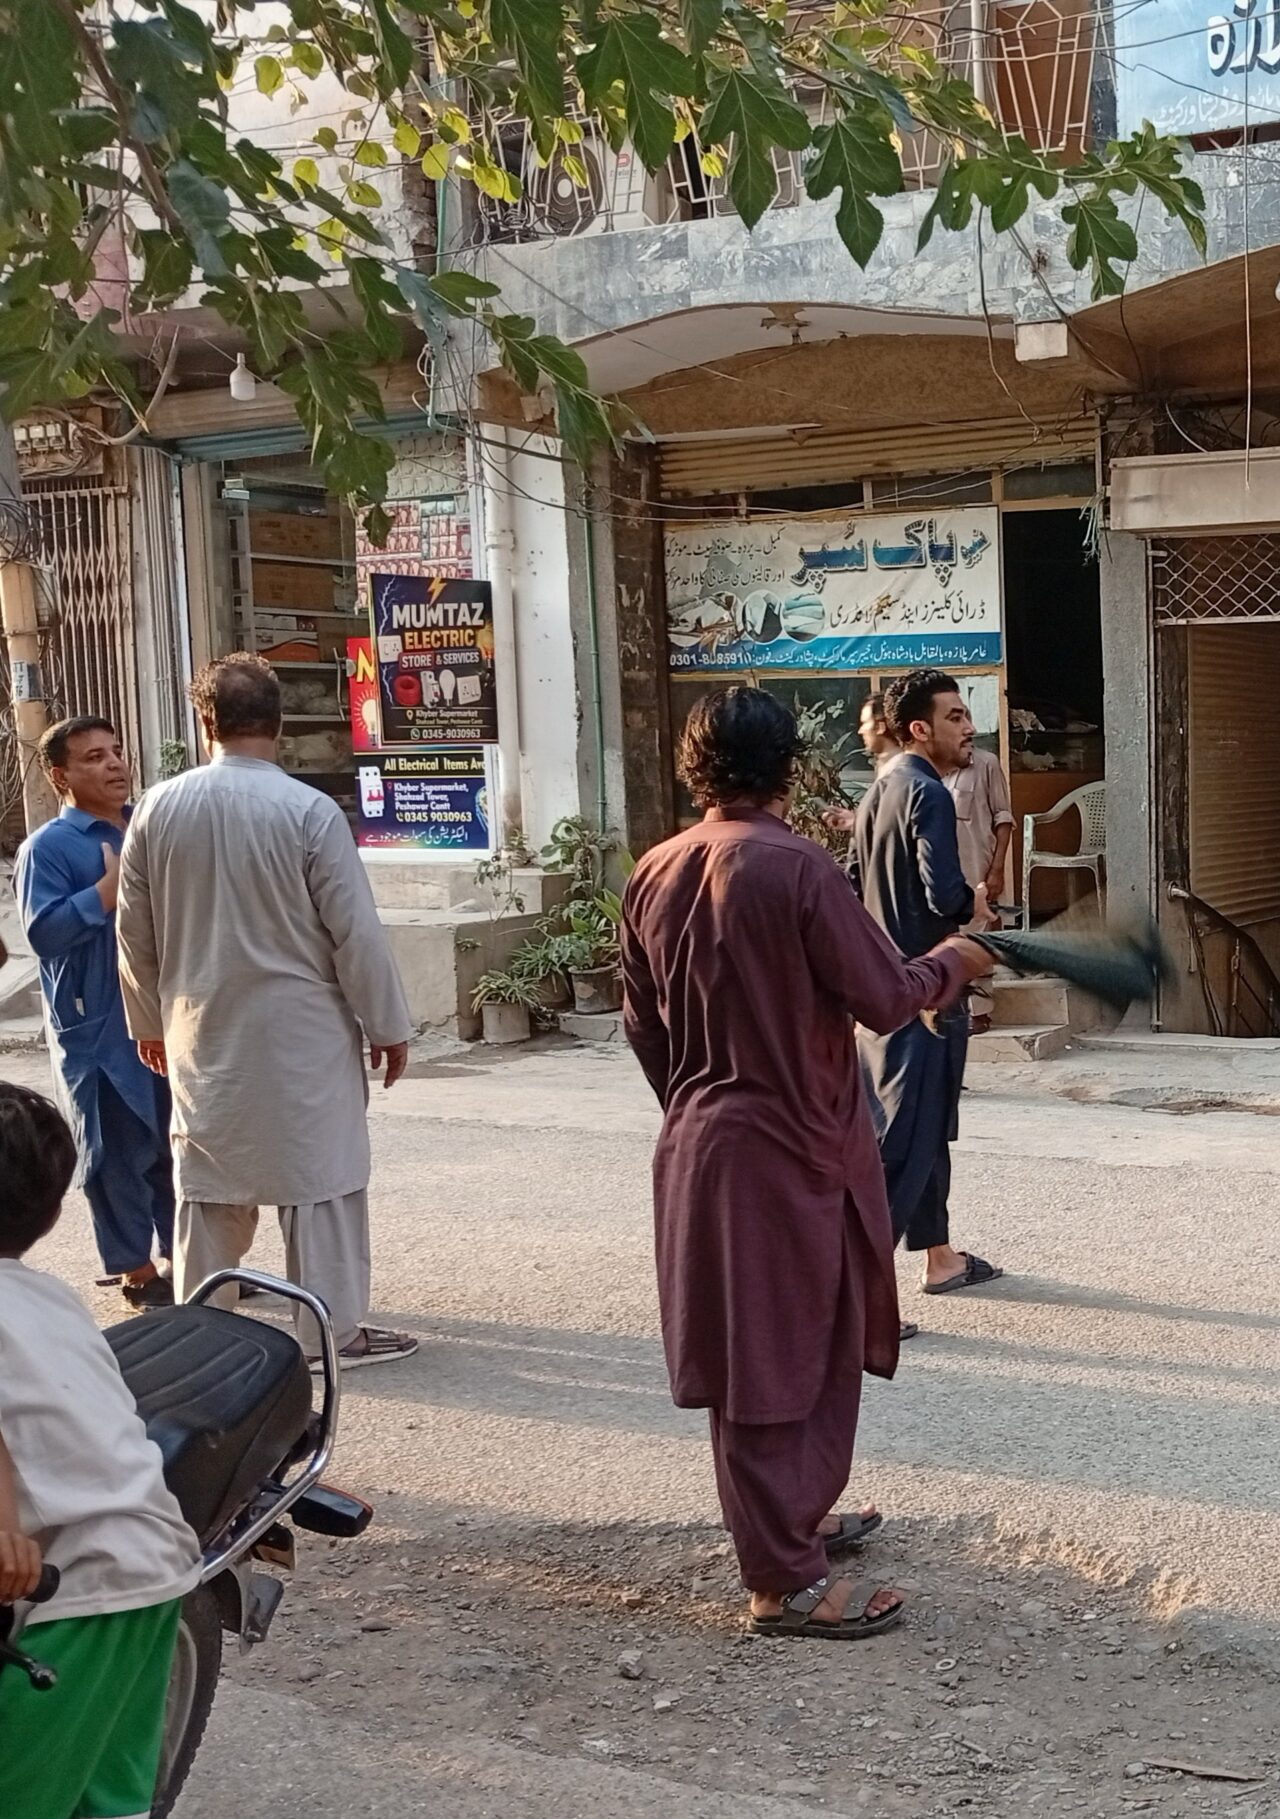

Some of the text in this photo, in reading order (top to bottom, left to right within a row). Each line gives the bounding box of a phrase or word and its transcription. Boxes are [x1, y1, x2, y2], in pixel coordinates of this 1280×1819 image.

[872, 517, 958, 588] پاک
[771, 568, 786, 584] اور
[950, 590, 986, 624] ڈرائی
[391, 602, 485, 629] MUMTAZ
[404, 629, 475, 650] ELECTRIC
[401, 651, 480, 668] STORE & SERVICES
[415, 709, 479, 719] Khyber Supermarket
[421, 728, 481, 739] 0345-9030963
[384, 758, 396, 771] All
[399, 757, 439, 772] Electrical
[443, 757, 469, 771] Items
[394, 781, 469, 794] Khyber Supermarket,
[394, 791, 449, 803] Shahzad Tower,
[395, 801, 451, 811] Peshawar Cantt
[404, 811, 472, 823] 0345 9030963
